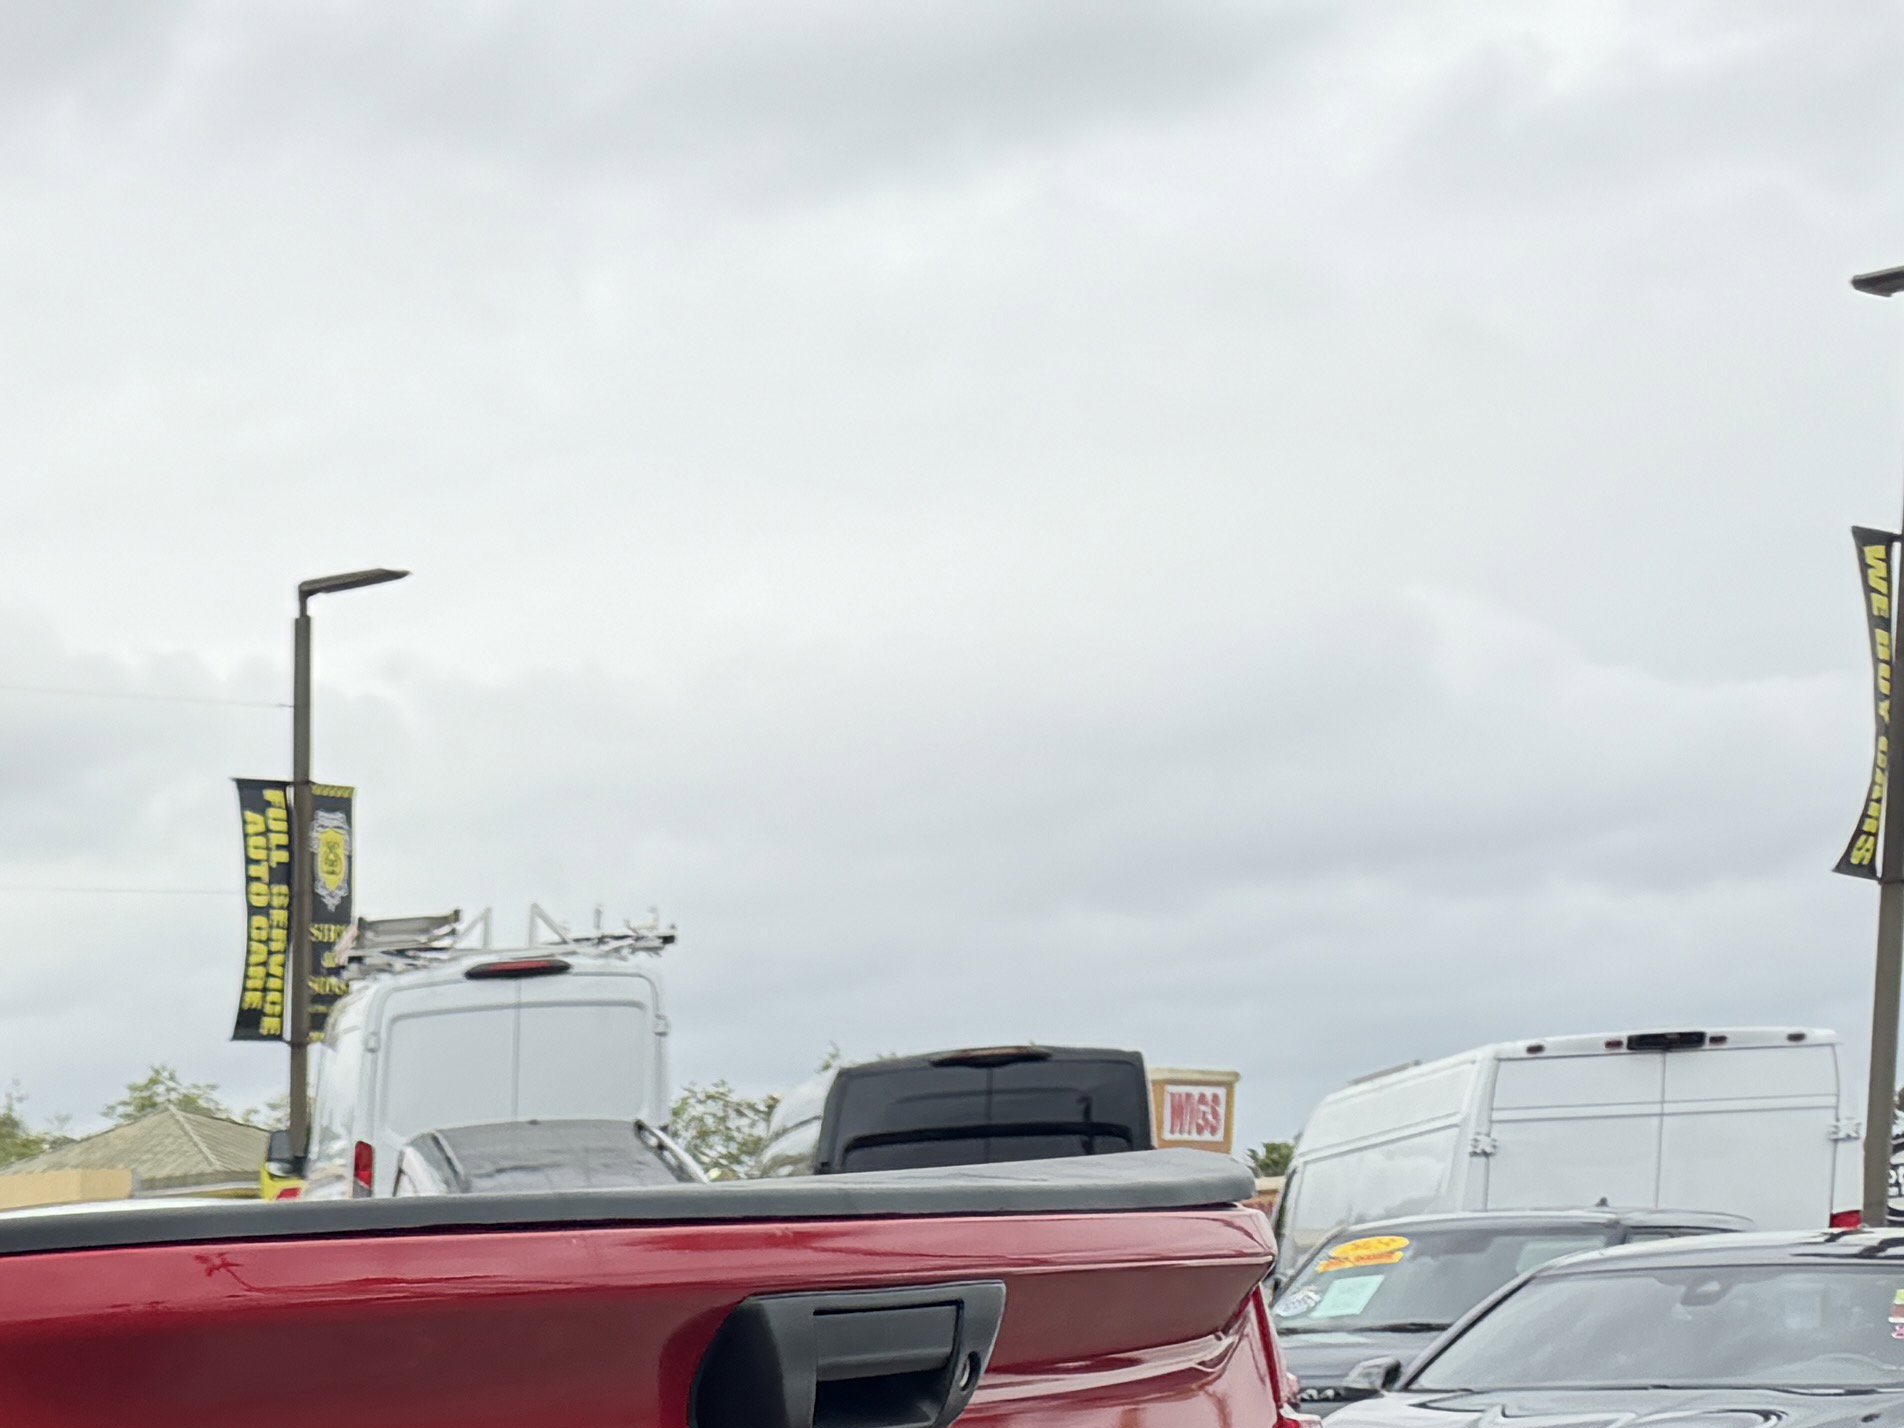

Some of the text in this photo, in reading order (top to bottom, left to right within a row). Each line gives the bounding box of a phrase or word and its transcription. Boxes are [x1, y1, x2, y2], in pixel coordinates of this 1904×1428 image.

[241, 810, 270, 1010] AUTO CARE
[258, 788, 290, 1036] FULL SERVICE
